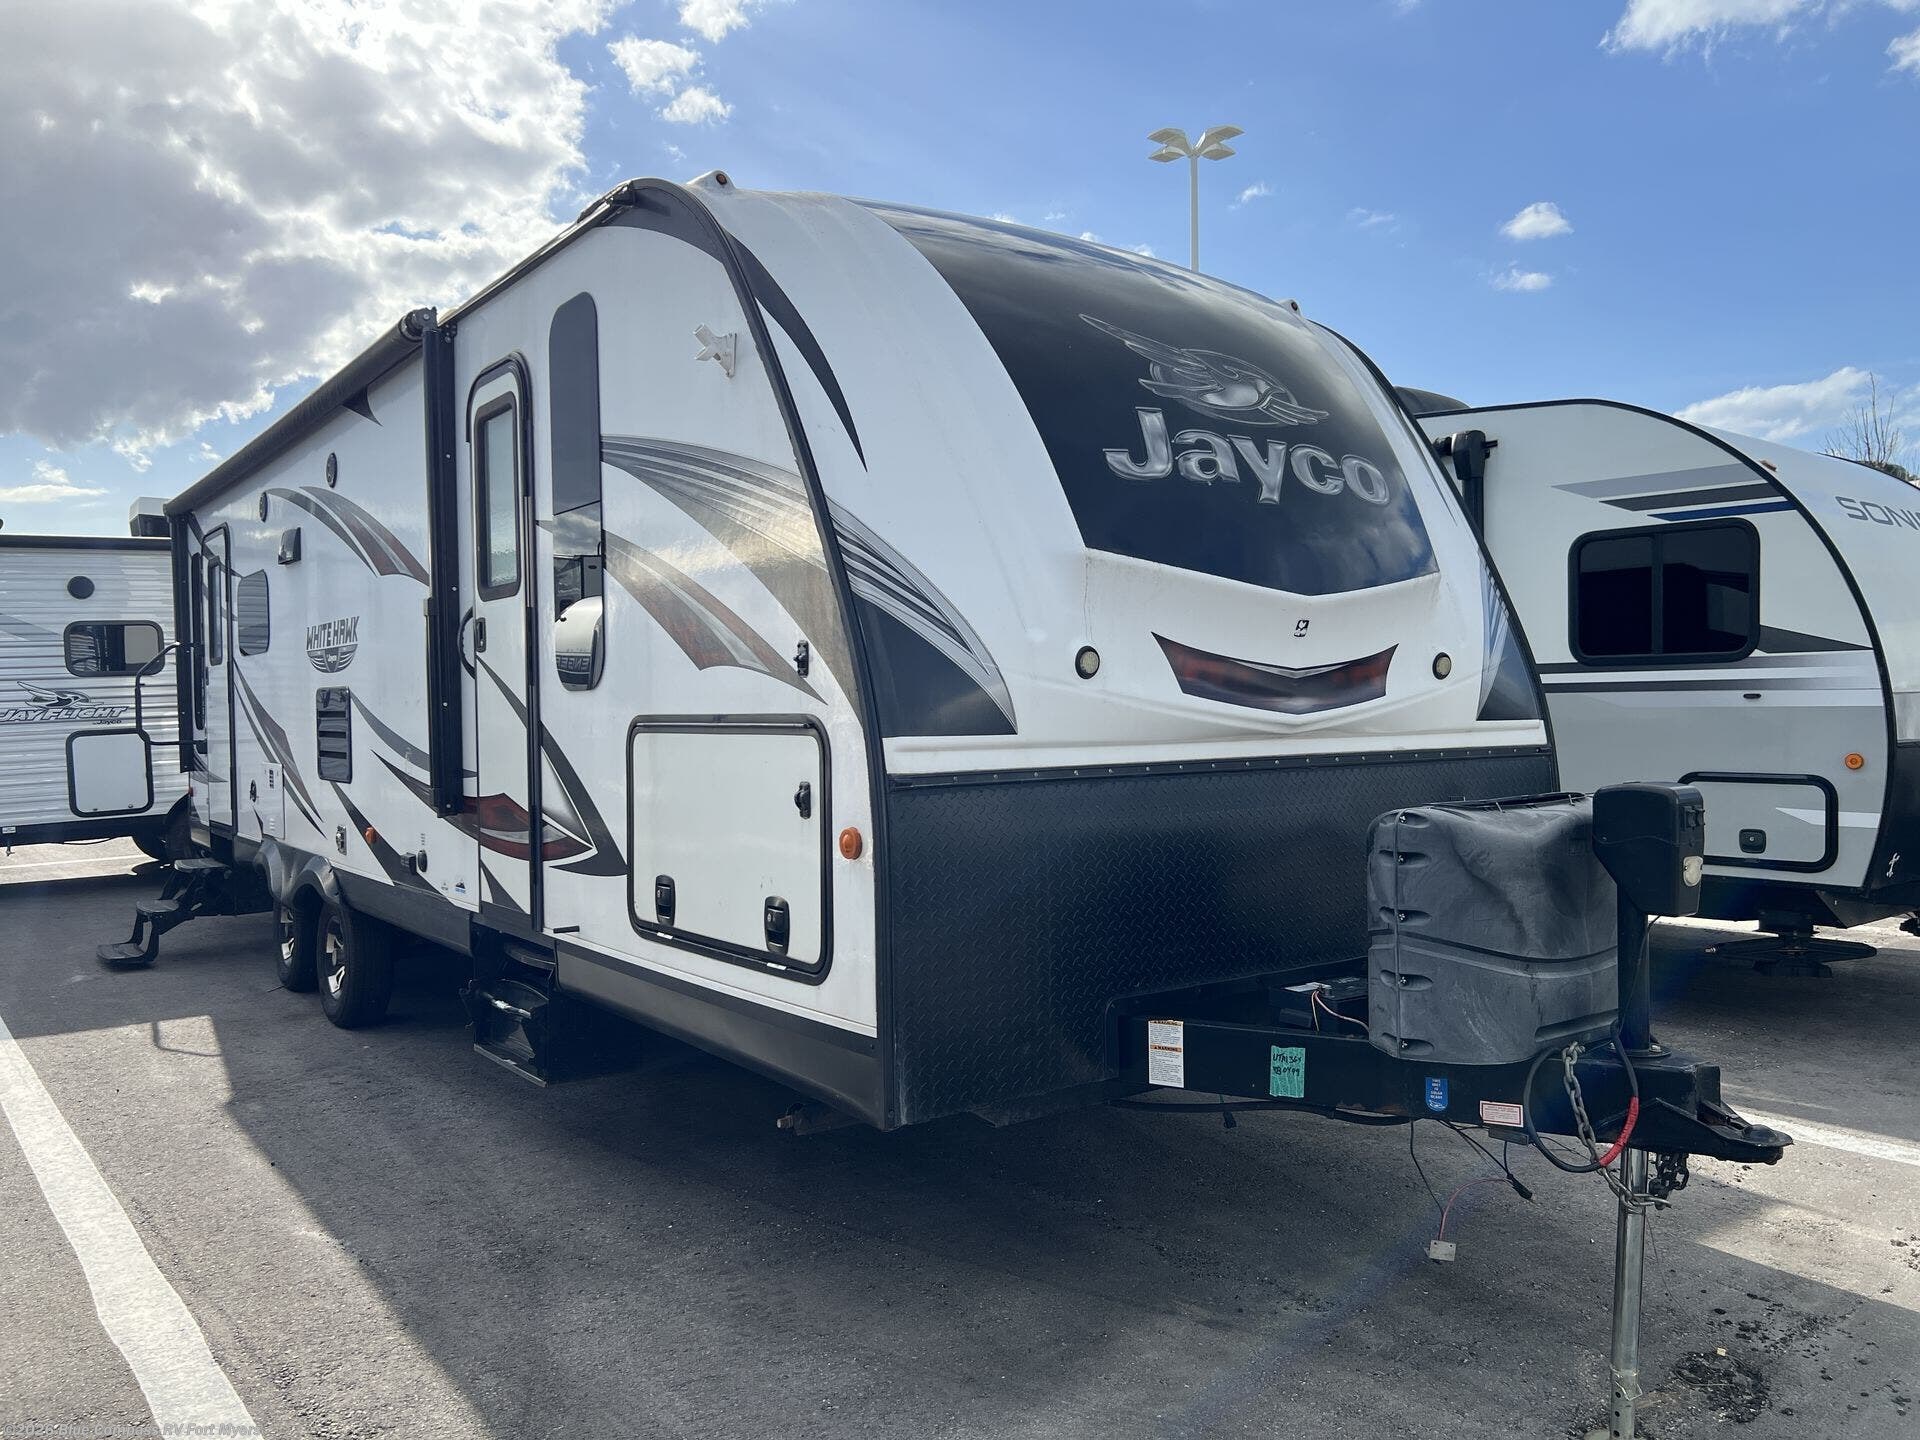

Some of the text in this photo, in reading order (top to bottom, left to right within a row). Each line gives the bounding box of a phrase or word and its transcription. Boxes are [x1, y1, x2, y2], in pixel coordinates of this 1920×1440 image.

[1103, 406, 1391, 505] Jayco
[1835, 496, 1920, 530] SONI
[306, 616, 360, 650] WHITE HAWK
[42, 705, 129, 720] FLIGHT
